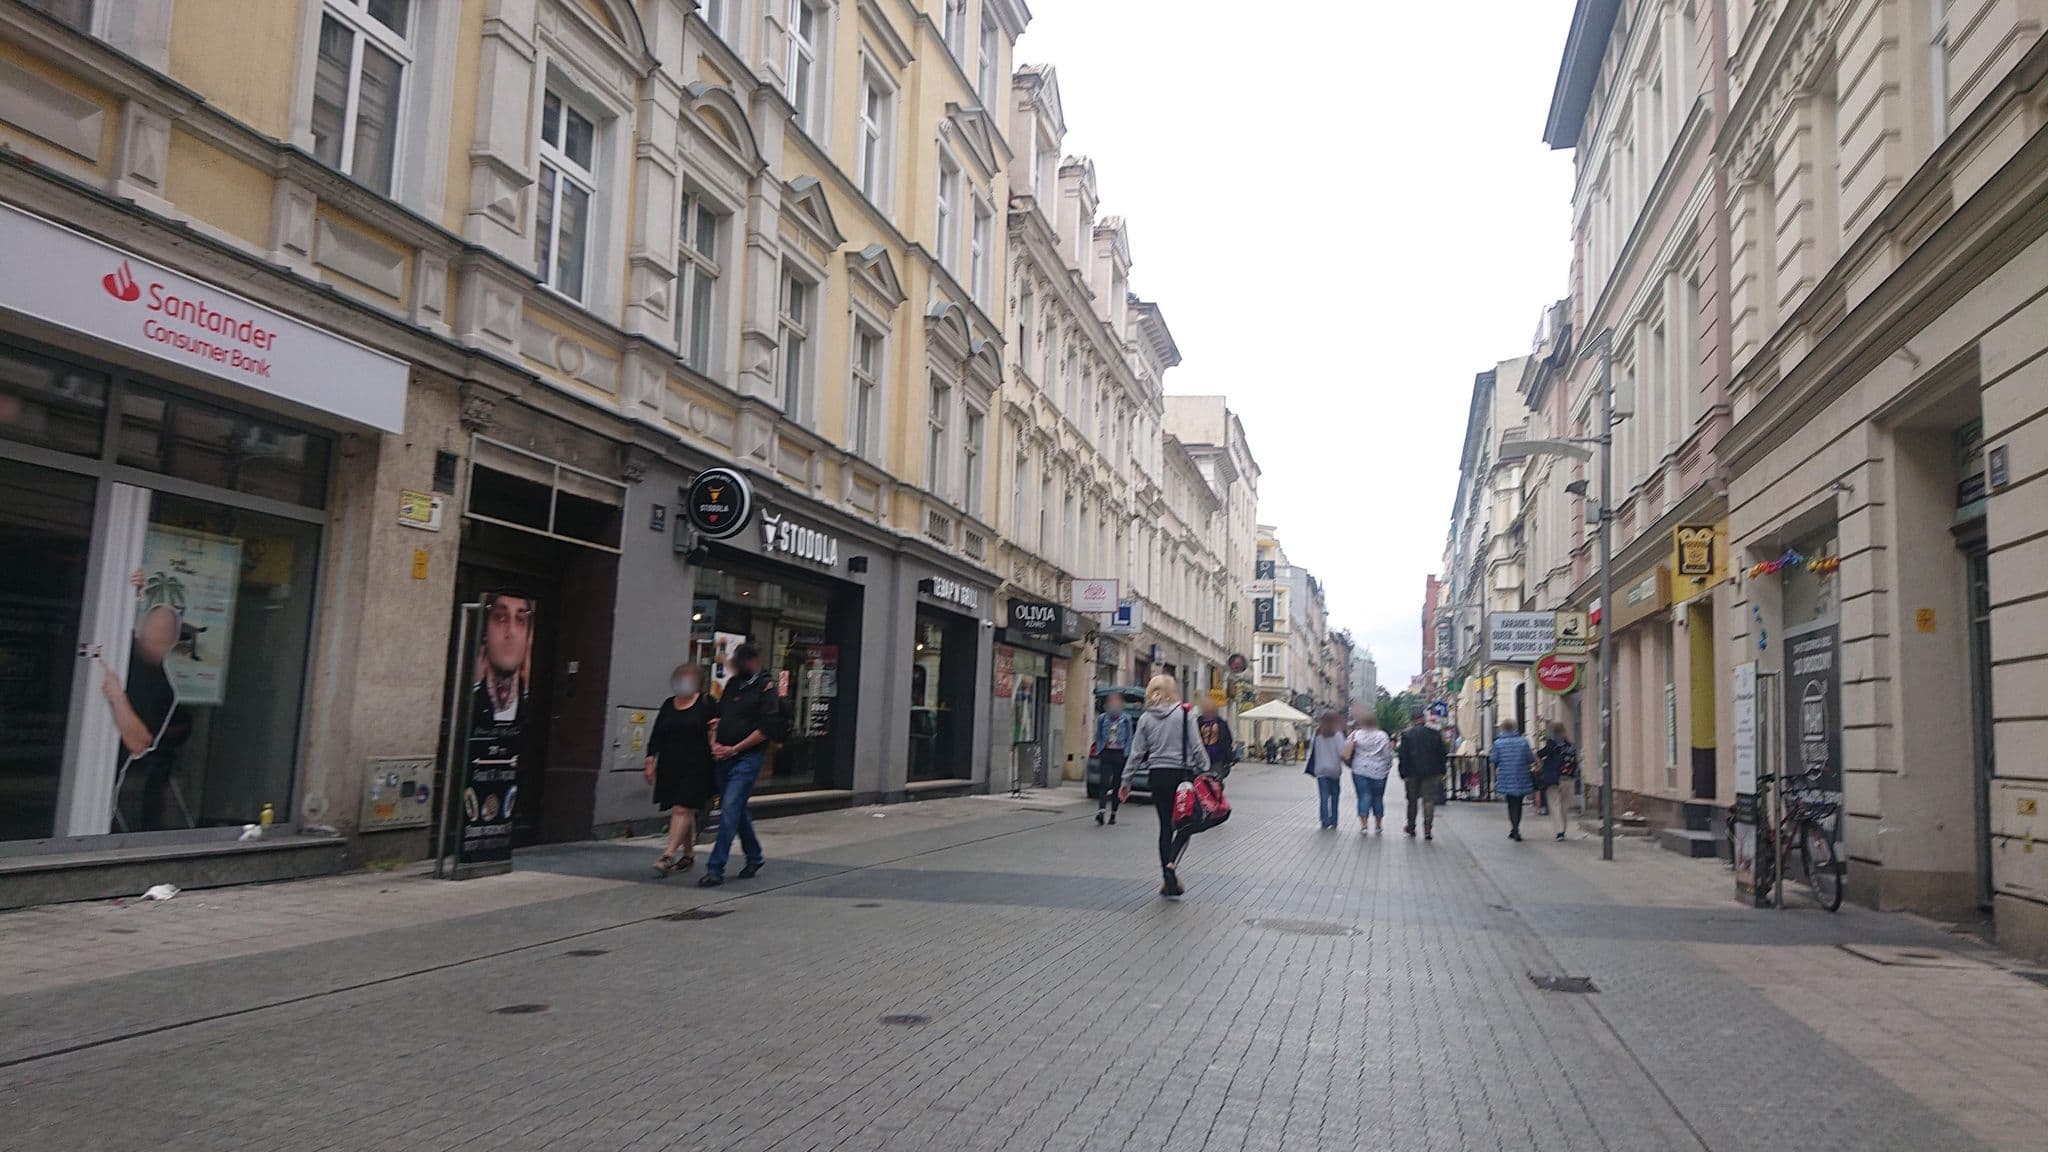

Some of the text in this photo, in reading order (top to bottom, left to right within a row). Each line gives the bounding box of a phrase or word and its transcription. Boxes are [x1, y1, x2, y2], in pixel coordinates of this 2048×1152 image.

[147, 283, 277, 351] Santander
[143, 319, 271, 377] Consumer Bank
[780, 521, 839, 566] STODOLA
[1015, 604, 1056, 622] OLIVIA
